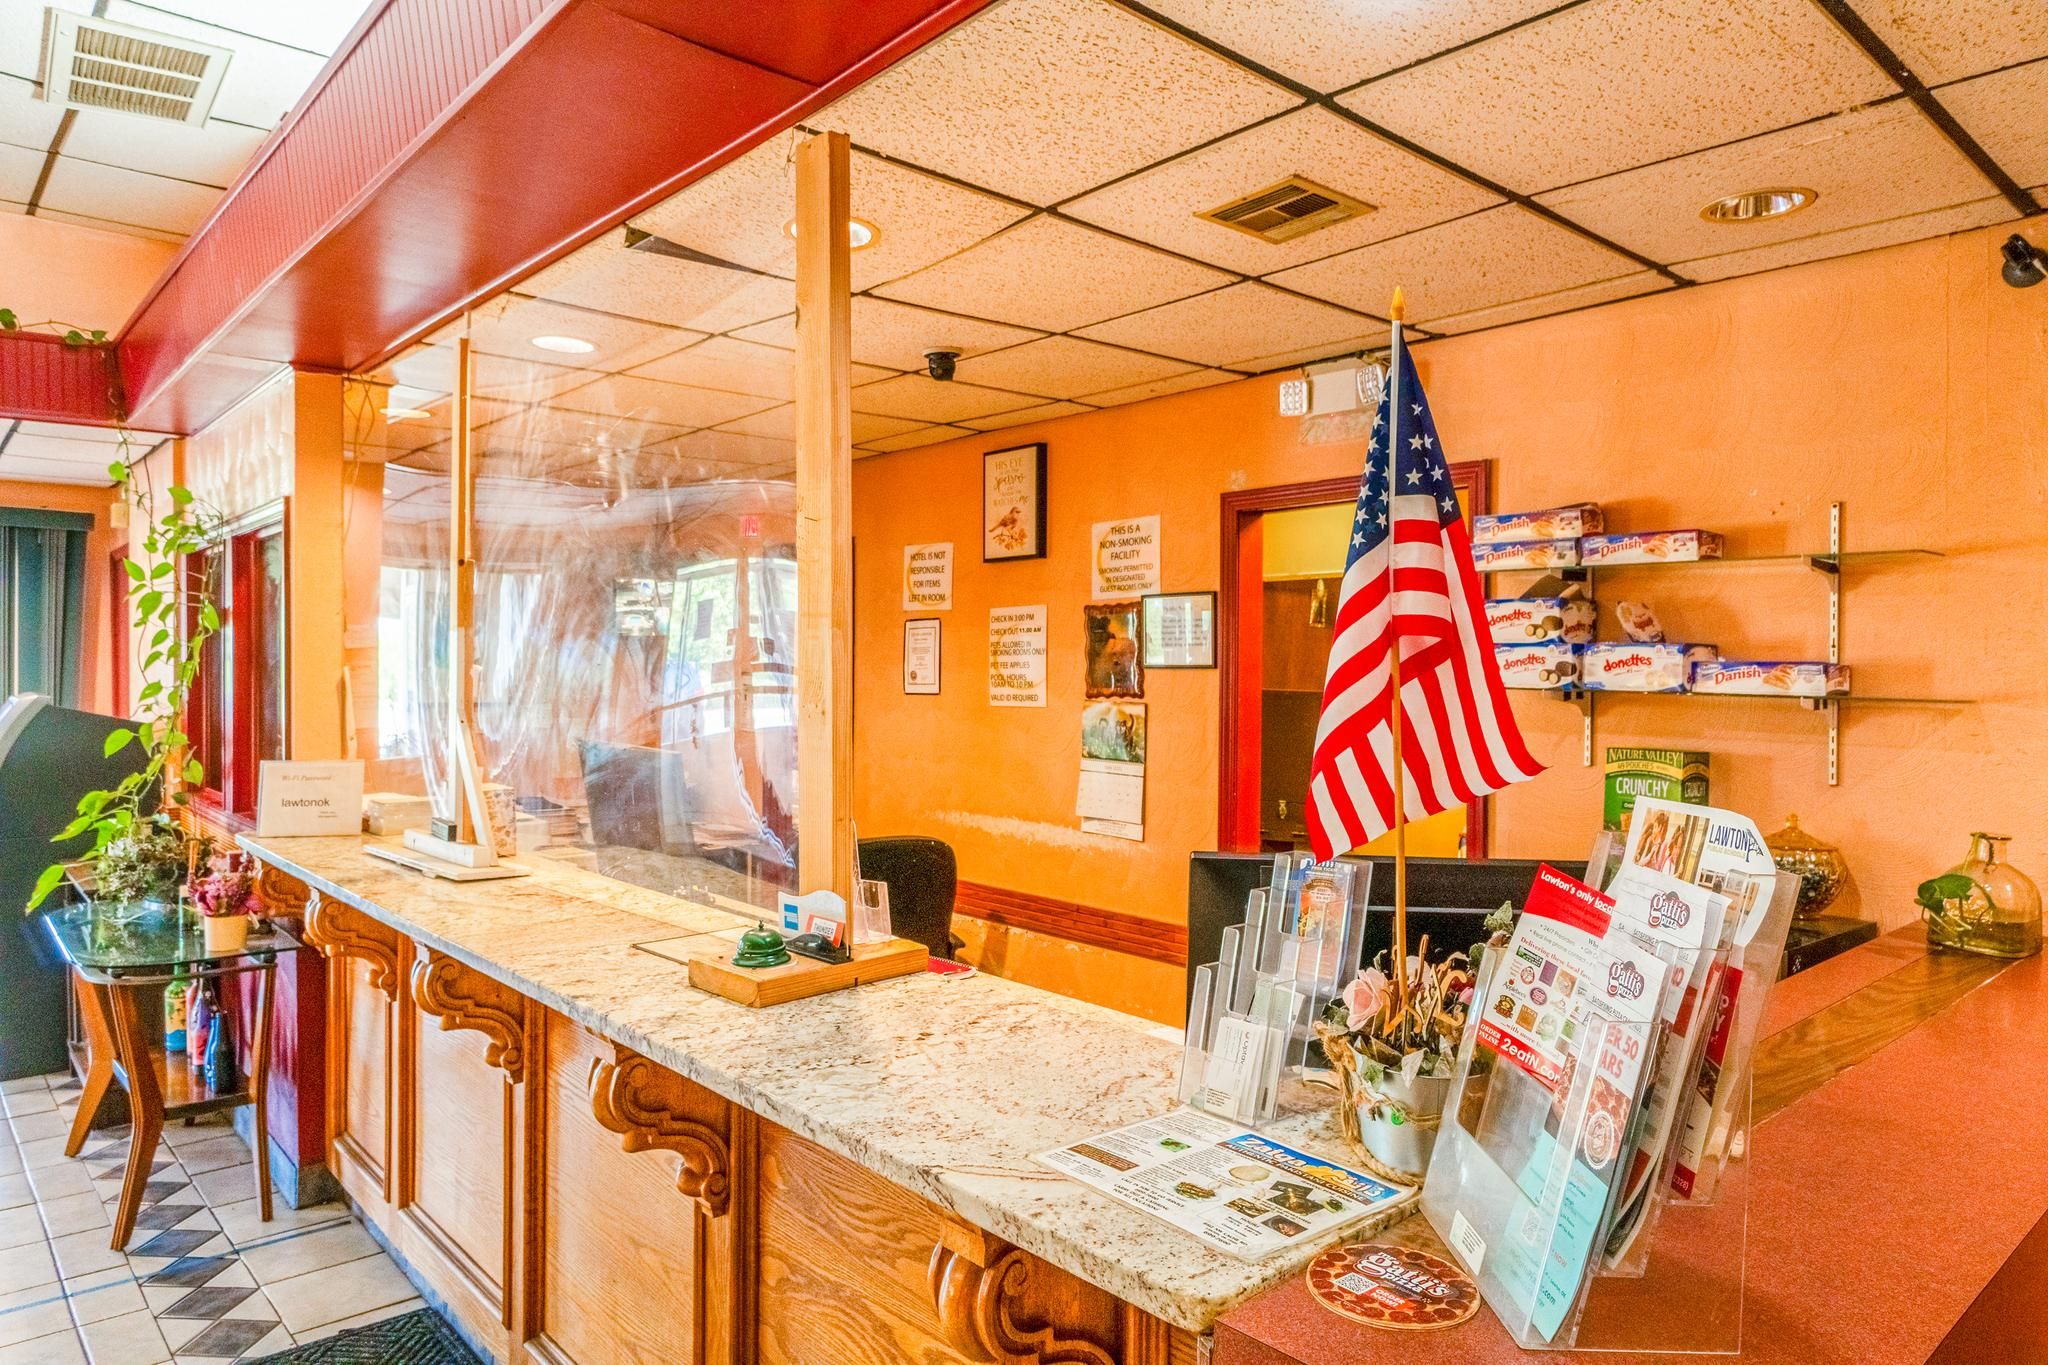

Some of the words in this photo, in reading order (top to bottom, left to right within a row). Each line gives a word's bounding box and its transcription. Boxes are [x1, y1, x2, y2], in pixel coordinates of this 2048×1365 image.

[1111, 525, 1126, 535] THIS
[1127, 524, 1134, 534] IS
[1135, 524, 1141, 532] A
[1492, 518, 1530, 536] Danish
[1100, 535, 1153, 549] NON-SMOKING
[1600, 538, 1642, 558] Danish
[910, 552, 926, 561] HOTEL
[928, 551, 933, 560] IS
[934, 551, 946, 560] NOT
[1110, 549, 1141, 560] FACILITY
[1486, 547, 1524, 564] Danish
[911, 565, 945, 574] RESPONSIBLE
[1098, 566, 1122, 575] SMOKING
[1123, 563, 1154, 572] PERMITTED
[1113, 573, 1146, 582] DESIGNATED
[914, 580, 924, 588] FOR
[925, 579, 941, 588] ITEMS
[909, 594, 921, 602] LEFT
[991, 615, 1007, 623] CHECK
[1026, 613, 1034, 621] PM
[1489, 608, 1532, 627] donettes
[991, 628, 1006, 636] CHECK
[1007, 627, 1018, 635] OUT
[1503, 653, 1546, 671] donettes
[1604, 653, 1652, 673] donettes
[991, 673, 1006, 681] POOL
[1007, 673, 1027, 681] HOURS
[1714, 667, 1761, 685] Danish
[991, 694, 1005, 702] VALID
[1012, 694, 1038, 702] REQUIRED
[1608, 748, 1644, 762] NATURE
[1645, 750, 1680, 768] VALLEY
[1616, 777, 1670, 798] CRUNCHY
[281, 797, 330, 808] lawtonok
[1708, 824, 1749, 852] LAWTON
[1541, 870, 1576, 894] Lawton's
[1576, 889, 1594, 905] only
[1594, 897, 1614, 914] loca
[1521, 937, 1551, 958] Delivering
[1608, 963, 1642, 995] gatti's
[1480, 1023, 1501, 1039] ORDER
[1623, 1035, 1639, 1060] 50
[1228, 1144, 1278, 1166] AUTHENTIC
[1277, 1163, 1325, 1186] PAKISTANI
[1326, 1182, 1367, 1202] CUISINE
[1356, 1254, 1450, 1296] gatti's
[1380, 1273, 1423, 1293] pizza
[1375, 1289, 1405, 1305] ORDER
